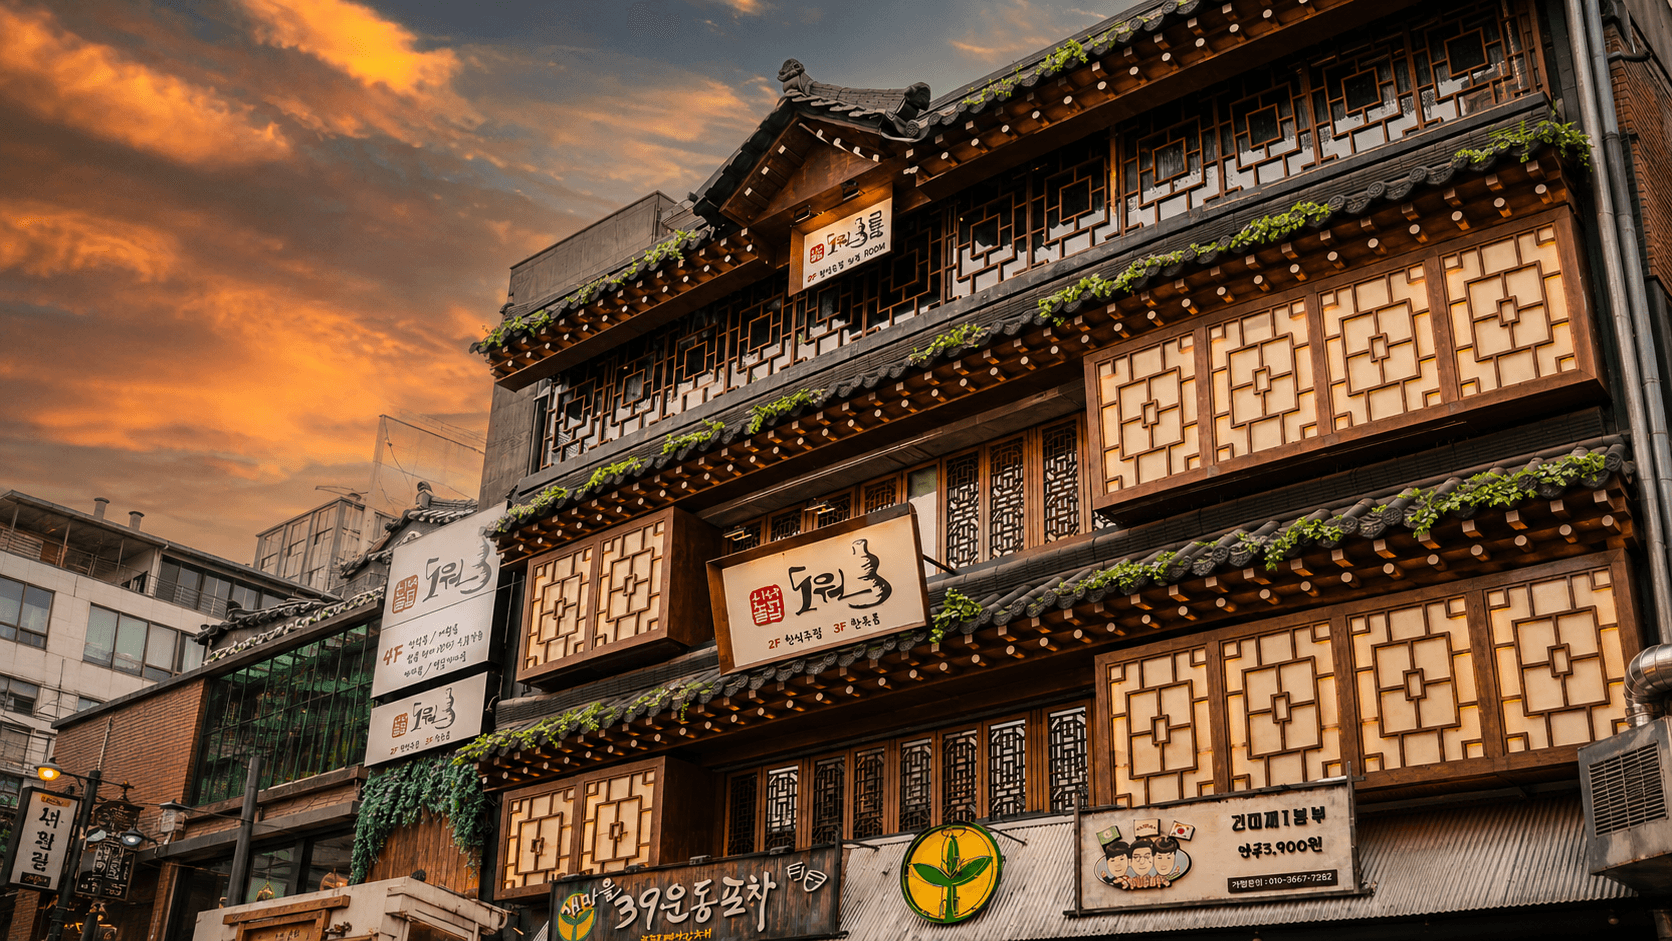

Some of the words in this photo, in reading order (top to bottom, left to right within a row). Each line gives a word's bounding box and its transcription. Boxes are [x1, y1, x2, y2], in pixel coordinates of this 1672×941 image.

[768, 638, 781, 649] 2F
[833, 622, 846, 633] 3F
[383, 644, 404, 666] 4F
[560, 877, 623, 917] 새마을
[614, 871, 777, 933] 39운동포차
